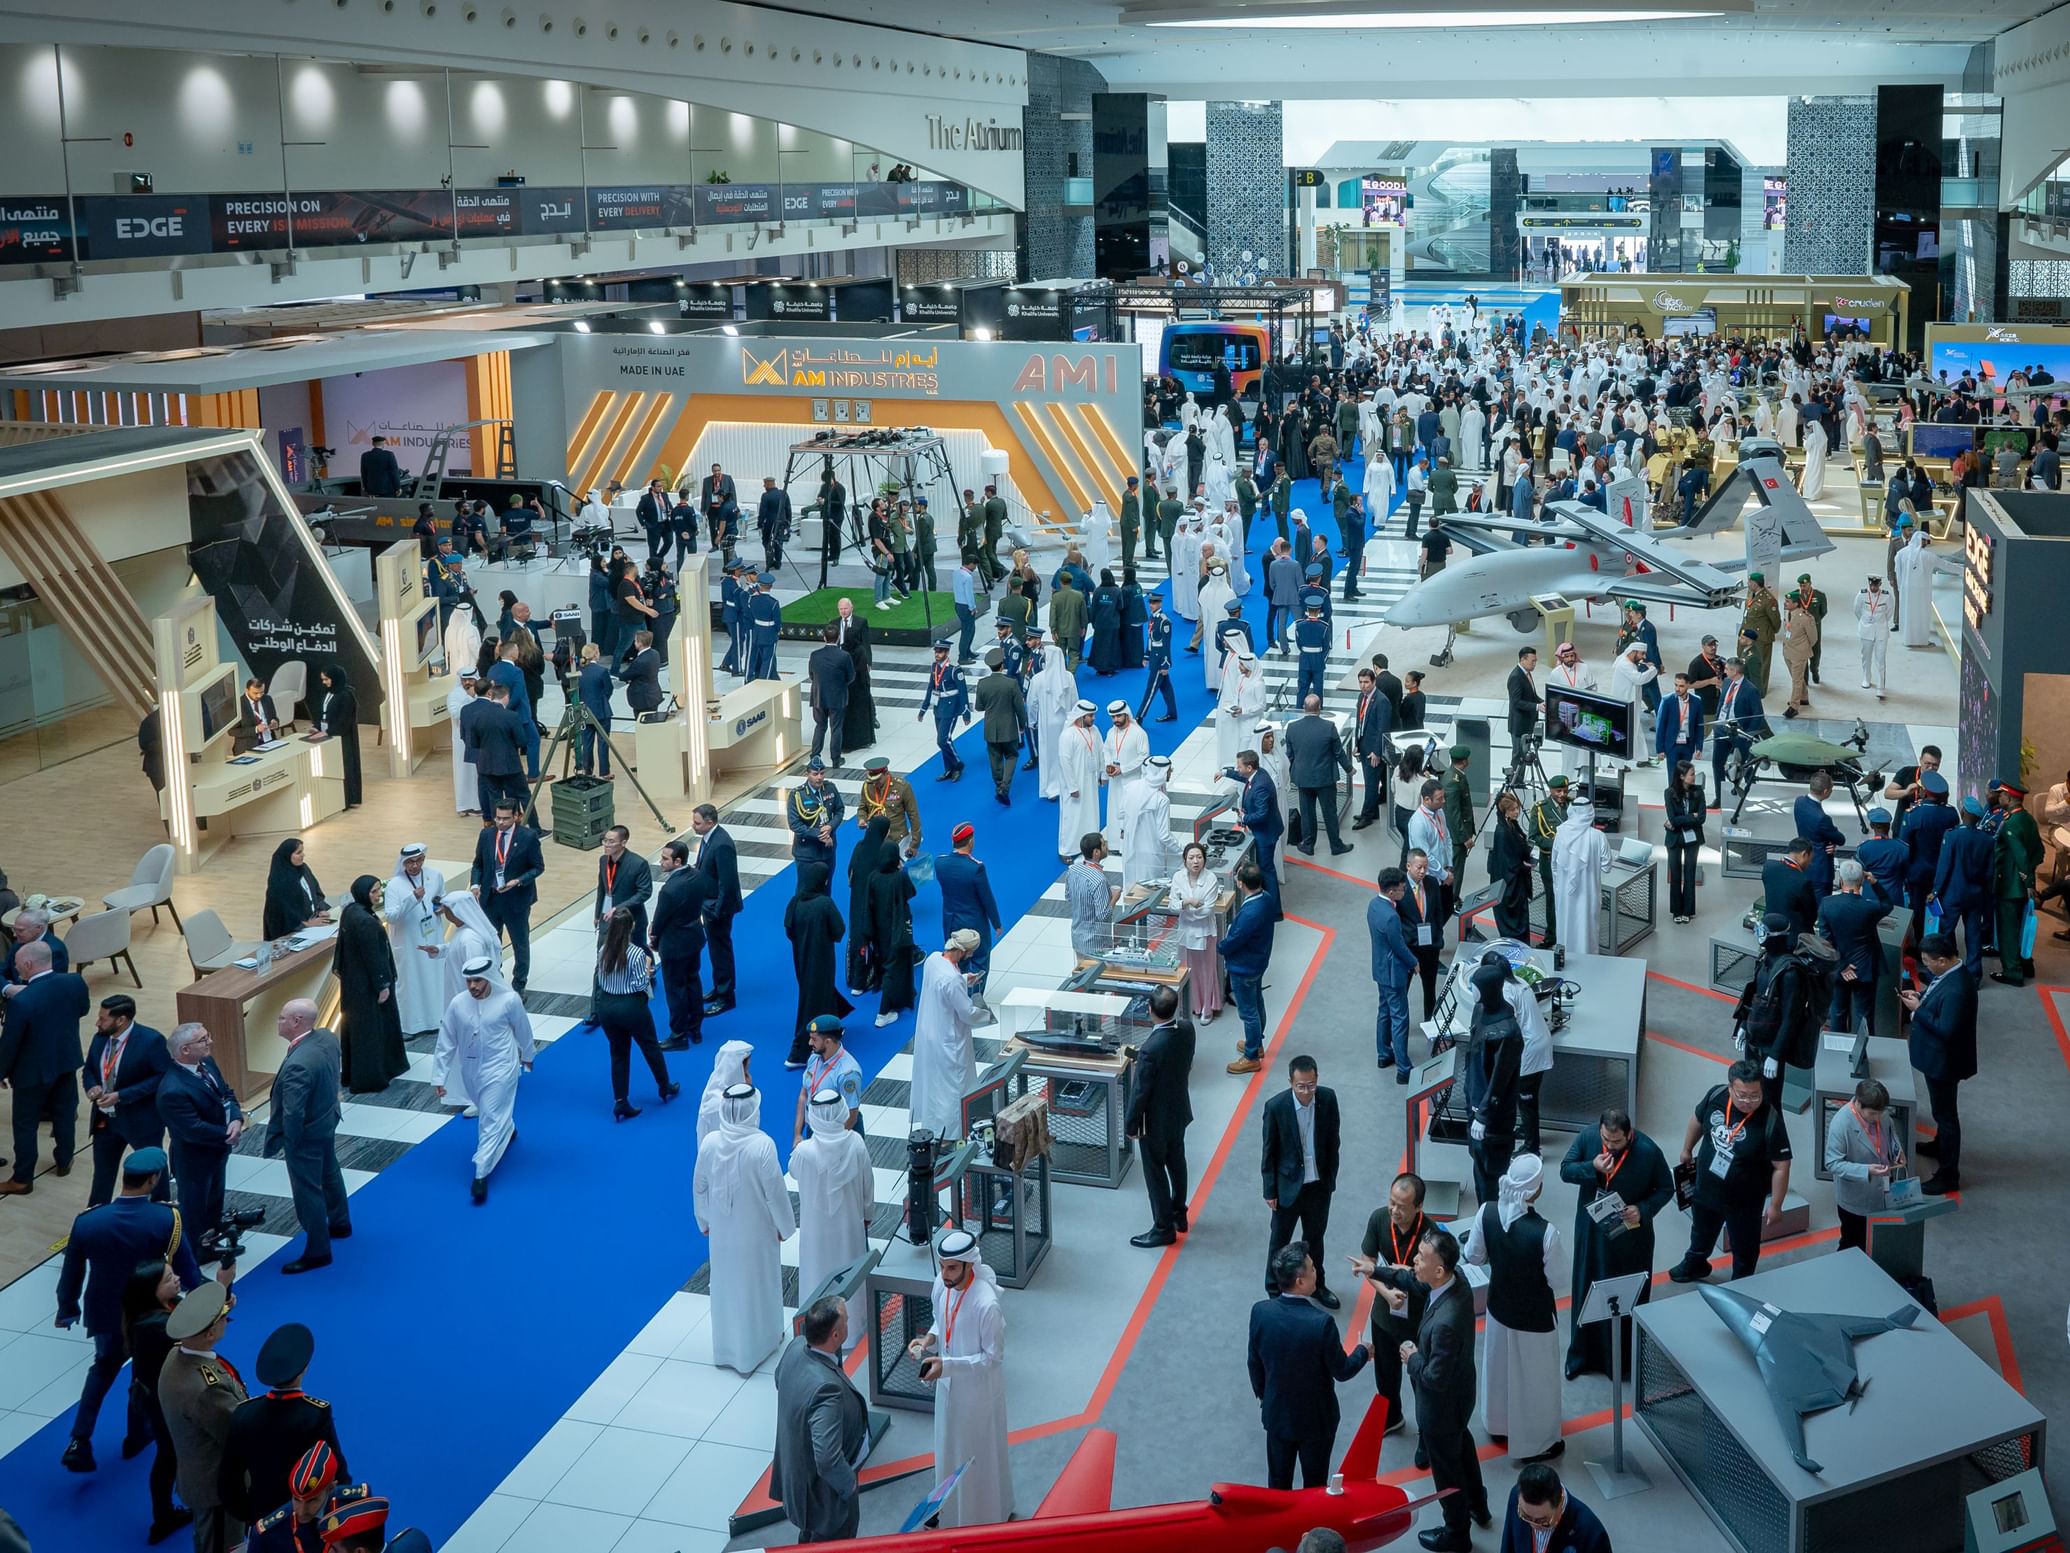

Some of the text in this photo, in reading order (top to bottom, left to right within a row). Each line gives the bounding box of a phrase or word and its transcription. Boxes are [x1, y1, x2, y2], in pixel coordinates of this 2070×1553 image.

[925, 114, 1022, 151] The Atrium
[1306, 172, 1315, 184] B
[457, 195, 510, 207] منتهى الدقة
[596, 191, 660, 204] PRECISION WITH
[784, 197, 808, 210] EDGE
[7, 206, 59, 221] منتهى
[226, 200, 320, 215] PRECISION ON
[598, 207, 624, 217] EVERY
[496, 211, 511, 225] في
[116, 216, 183, 239] EDGE
[227, 220, 270, 234] EVERY
[22, 231, 61, 248] جميع
[620, 365, 685, 376] MADE IN UAE
[1012, 353, 1117, 394] AMI
[792, 370, 826, 387] AM
[746, 710, 766, 727] SAAB
